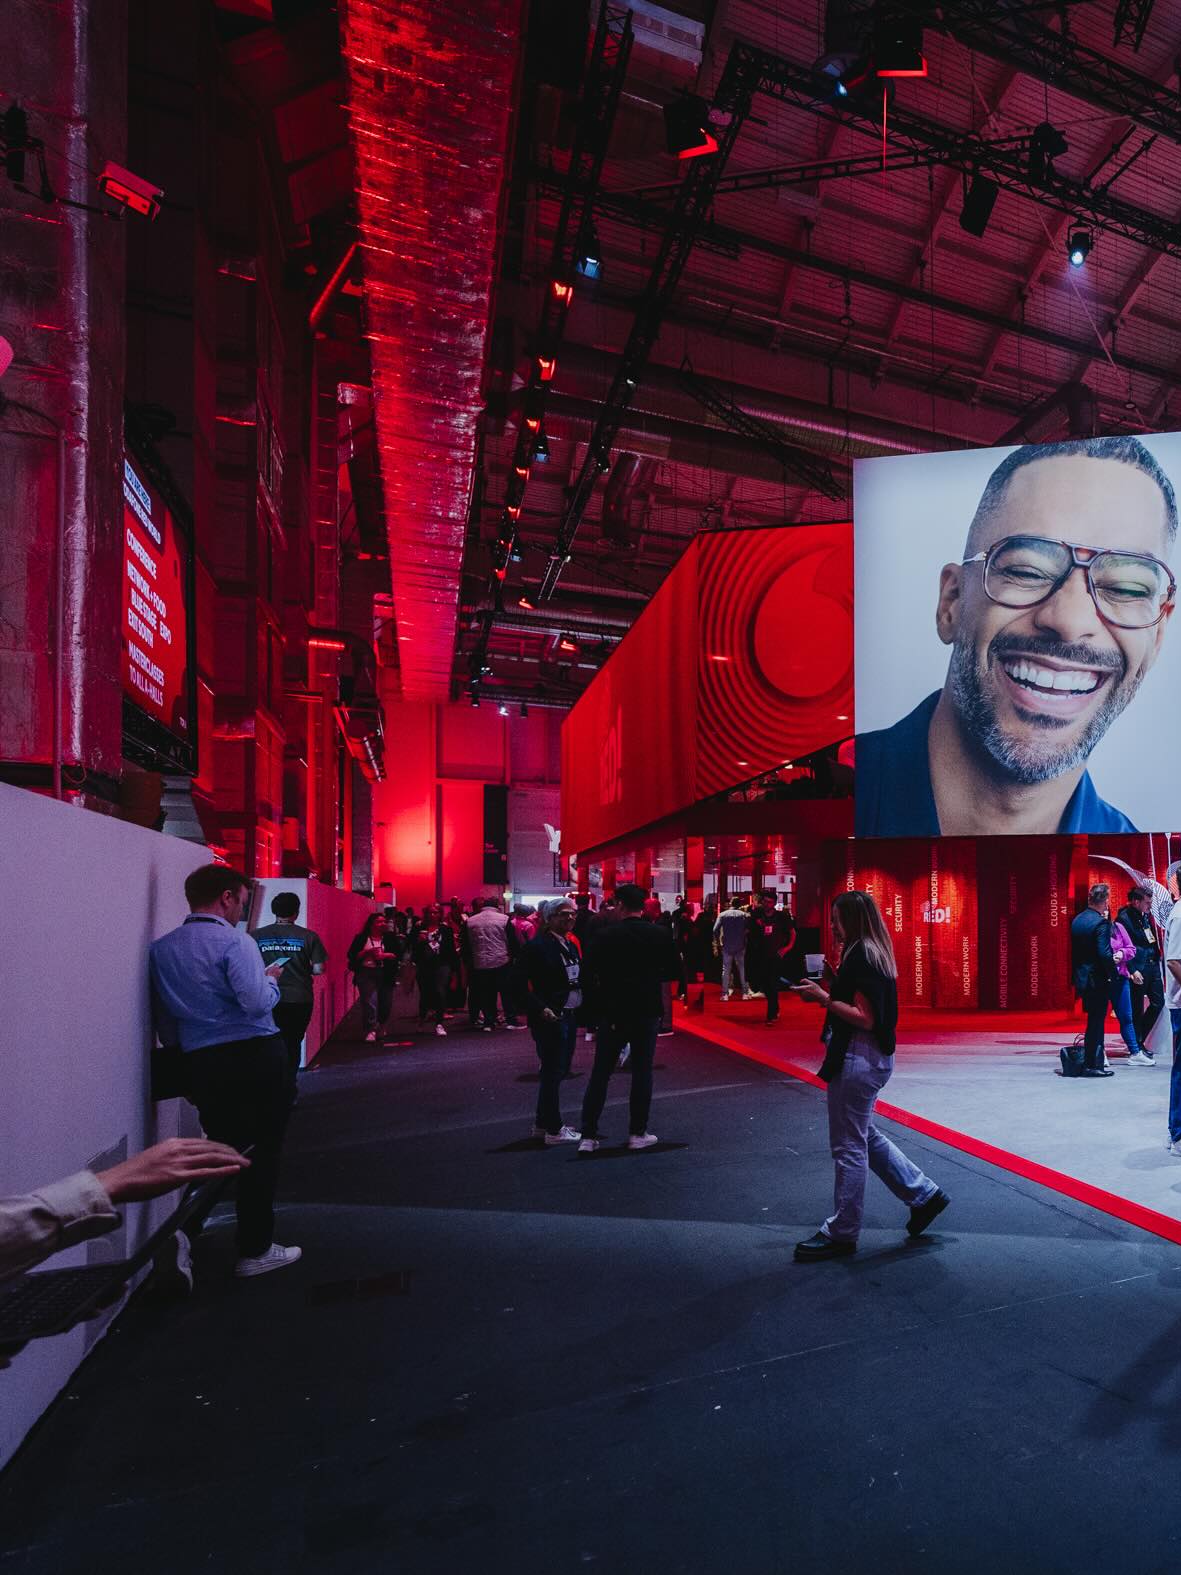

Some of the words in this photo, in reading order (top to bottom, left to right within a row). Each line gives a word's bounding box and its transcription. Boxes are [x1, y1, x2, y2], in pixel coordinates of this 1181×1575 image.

[126, 528, 157, 580] CONFERENCE
[127, 559, 150, 601] NETWORK
[153, 591, 167, 618] FOOD
[131, 587, 143, 615] BLUE
[159, 620, 172, 645] EXPO
[138, 617, 154, 649] SOUTH
[128, 639, 165, 688] MASTERCLASSES
[931, 869, 939, 906] MODERN
[886, 906, 893, 916] AI
[894, 893, 903, 933] SECURITY
[1050, 899, 1058, 927] CLOUD
[1060, 905, 1067, 916] AI
[915, 961, 923, 996] MODERN
[962, 961, 970, 996] MODERN
